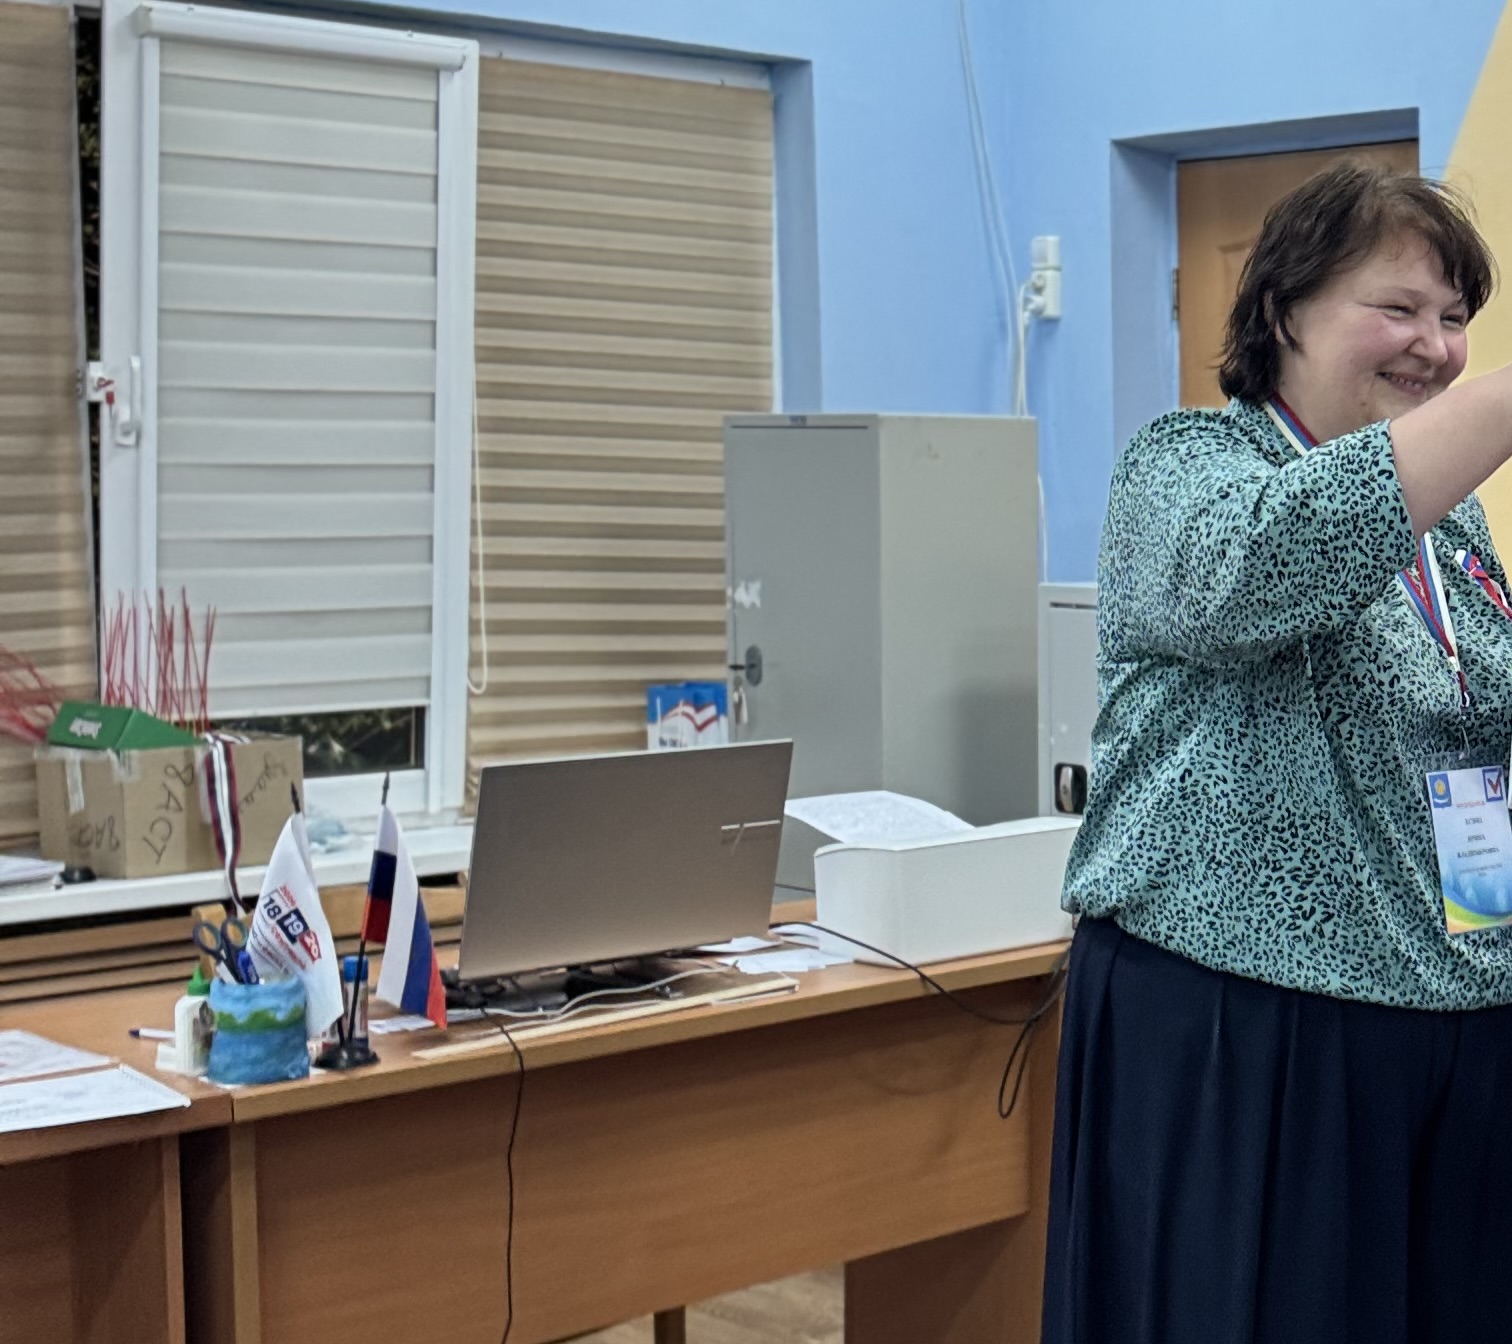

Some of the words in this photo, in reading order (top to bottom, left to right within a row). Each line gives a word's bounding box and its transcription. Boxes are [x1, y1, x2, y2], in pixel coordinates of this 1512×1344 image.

[263, 897, 282, 920] 18
[284, 912, 304, 936] 19
[304, 933, 318, 958] 20
